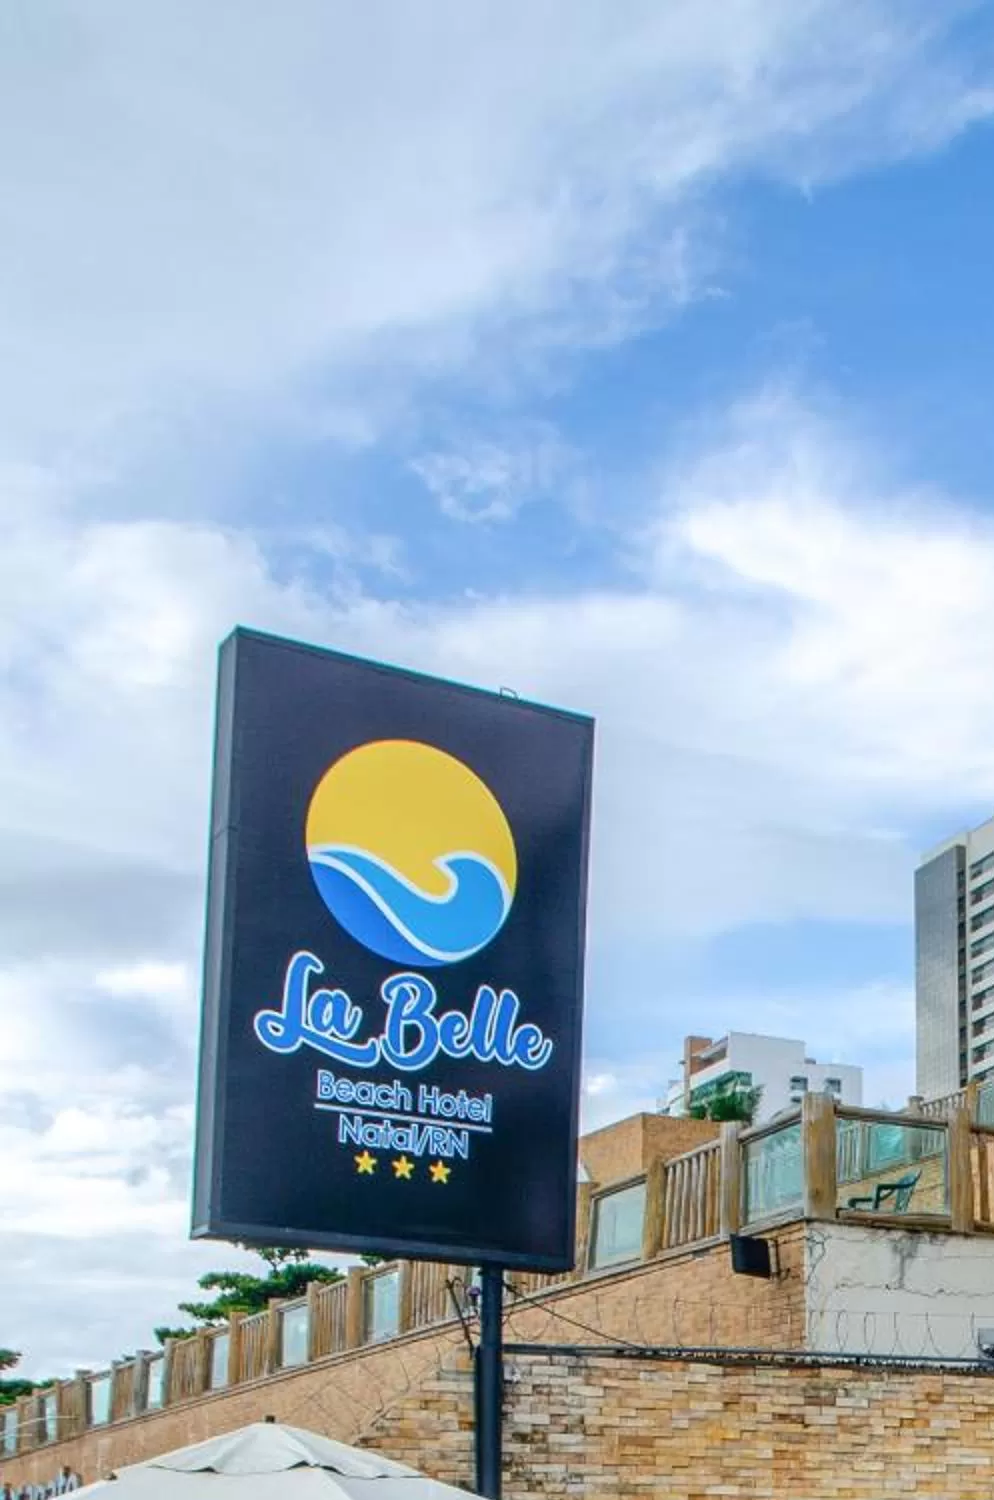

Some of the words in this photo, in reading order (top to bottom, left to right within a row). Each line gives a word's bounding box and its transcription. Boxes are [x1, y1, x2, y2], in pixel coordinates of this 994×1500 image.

[254, 950, 380, 1068] La
[379, 972, 553, 1071] Belle
[317, 1069, 412, 1111] Beach
[418, 1084, 493, 1123] Hotel
[338, 1114, 469, 1159] Natal/RN
